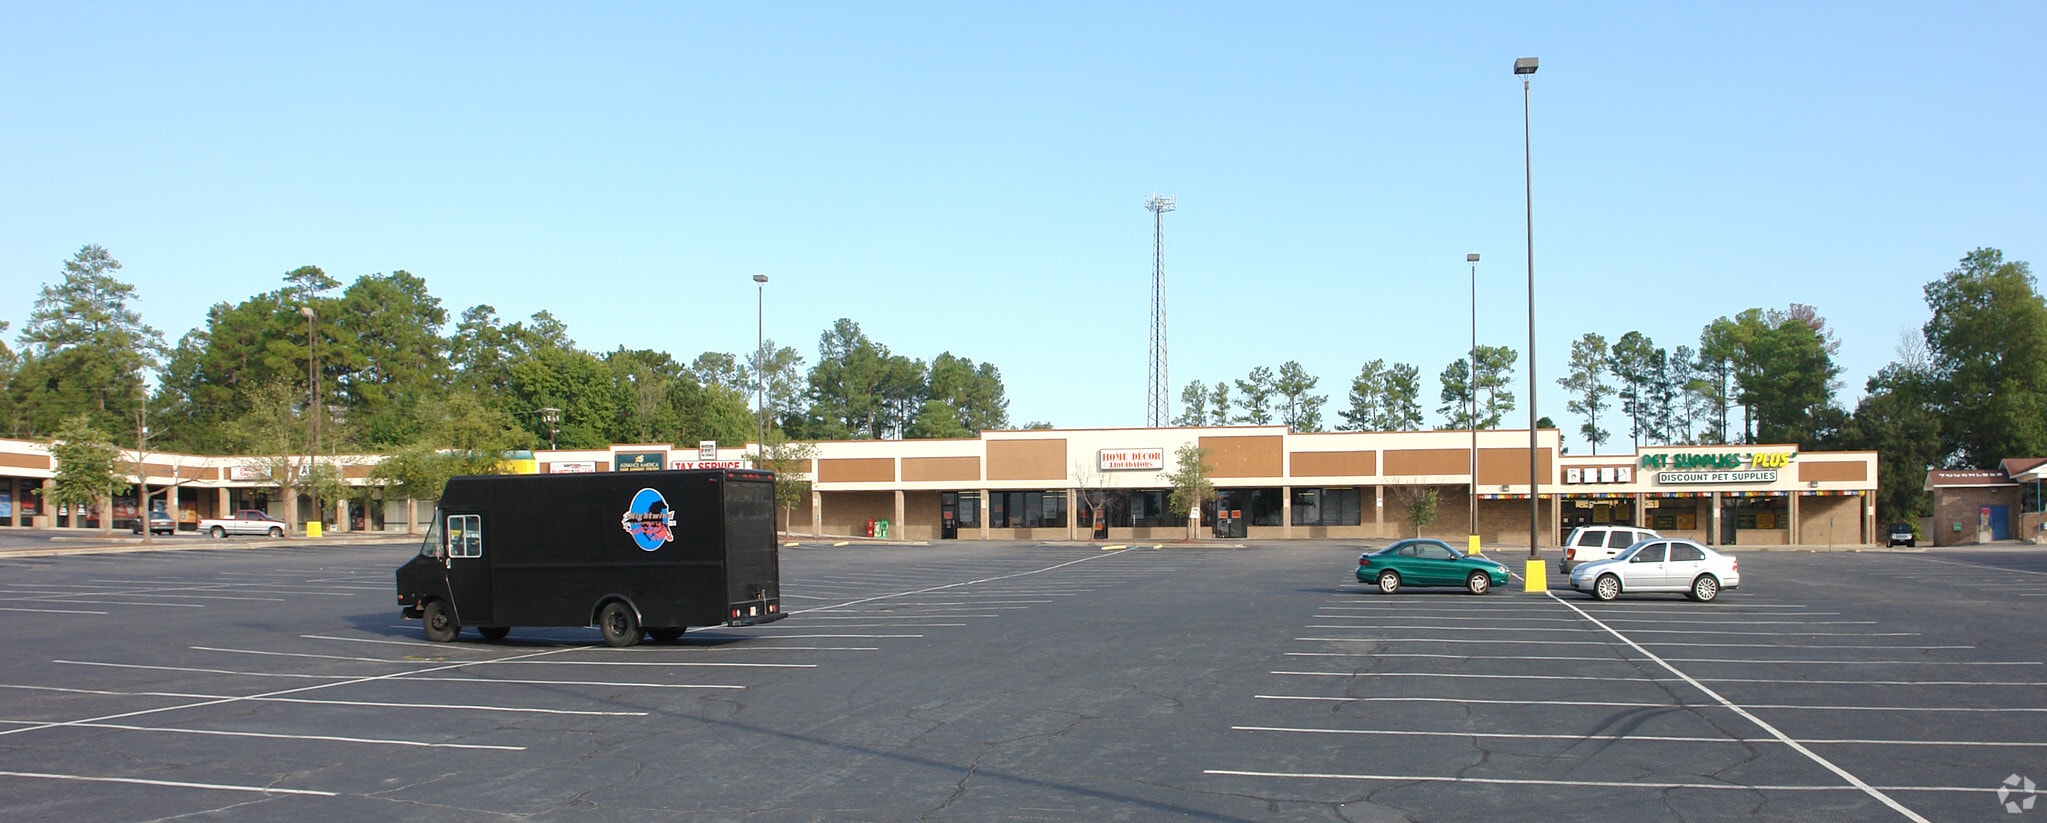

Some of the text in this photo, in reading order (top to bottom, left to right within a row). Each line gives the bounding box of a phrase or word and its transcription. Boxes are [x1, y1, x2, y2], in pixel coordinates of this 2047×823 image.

[1102, 453, 1128, 461] HOME
[1641, 453, 1668, 468] PET
[1673, 452, 1741, 469] SUPPLIES
[675, 461, 740, 470] TAX SERVICE
[1661, 472, 1775, 482] DISCOUNT PET SUPPLIES
